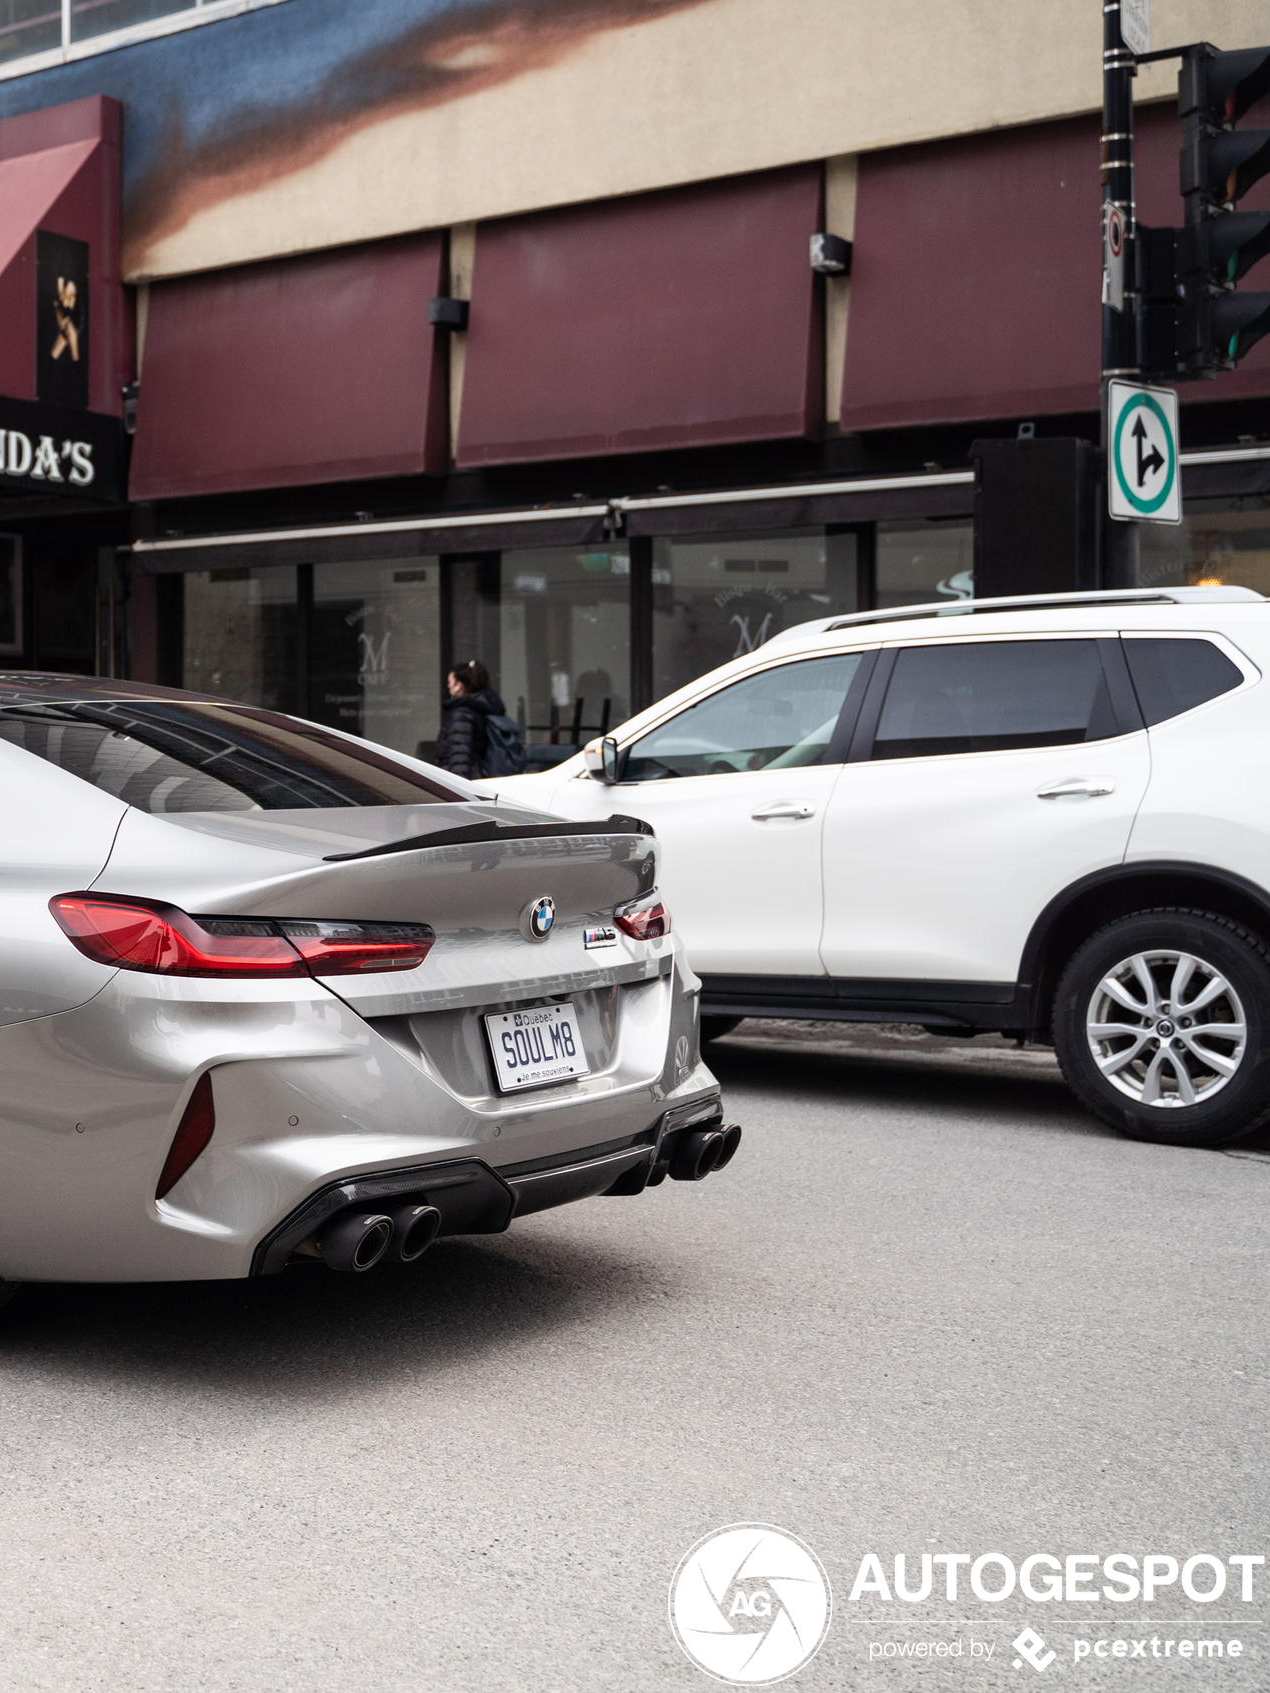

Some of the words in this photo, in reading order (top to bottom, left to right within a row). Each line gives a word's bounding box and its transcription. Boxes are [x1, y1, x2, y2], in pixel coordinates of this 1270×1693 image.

[522, 1012, 554, 1027] Québec
[501, 1021, 576, 1069] SOULM8
[521, 1072, 530, 1082] Je
[531, 1070, 541, 1080] me
[542, 1065, 570, 1077] souviens
